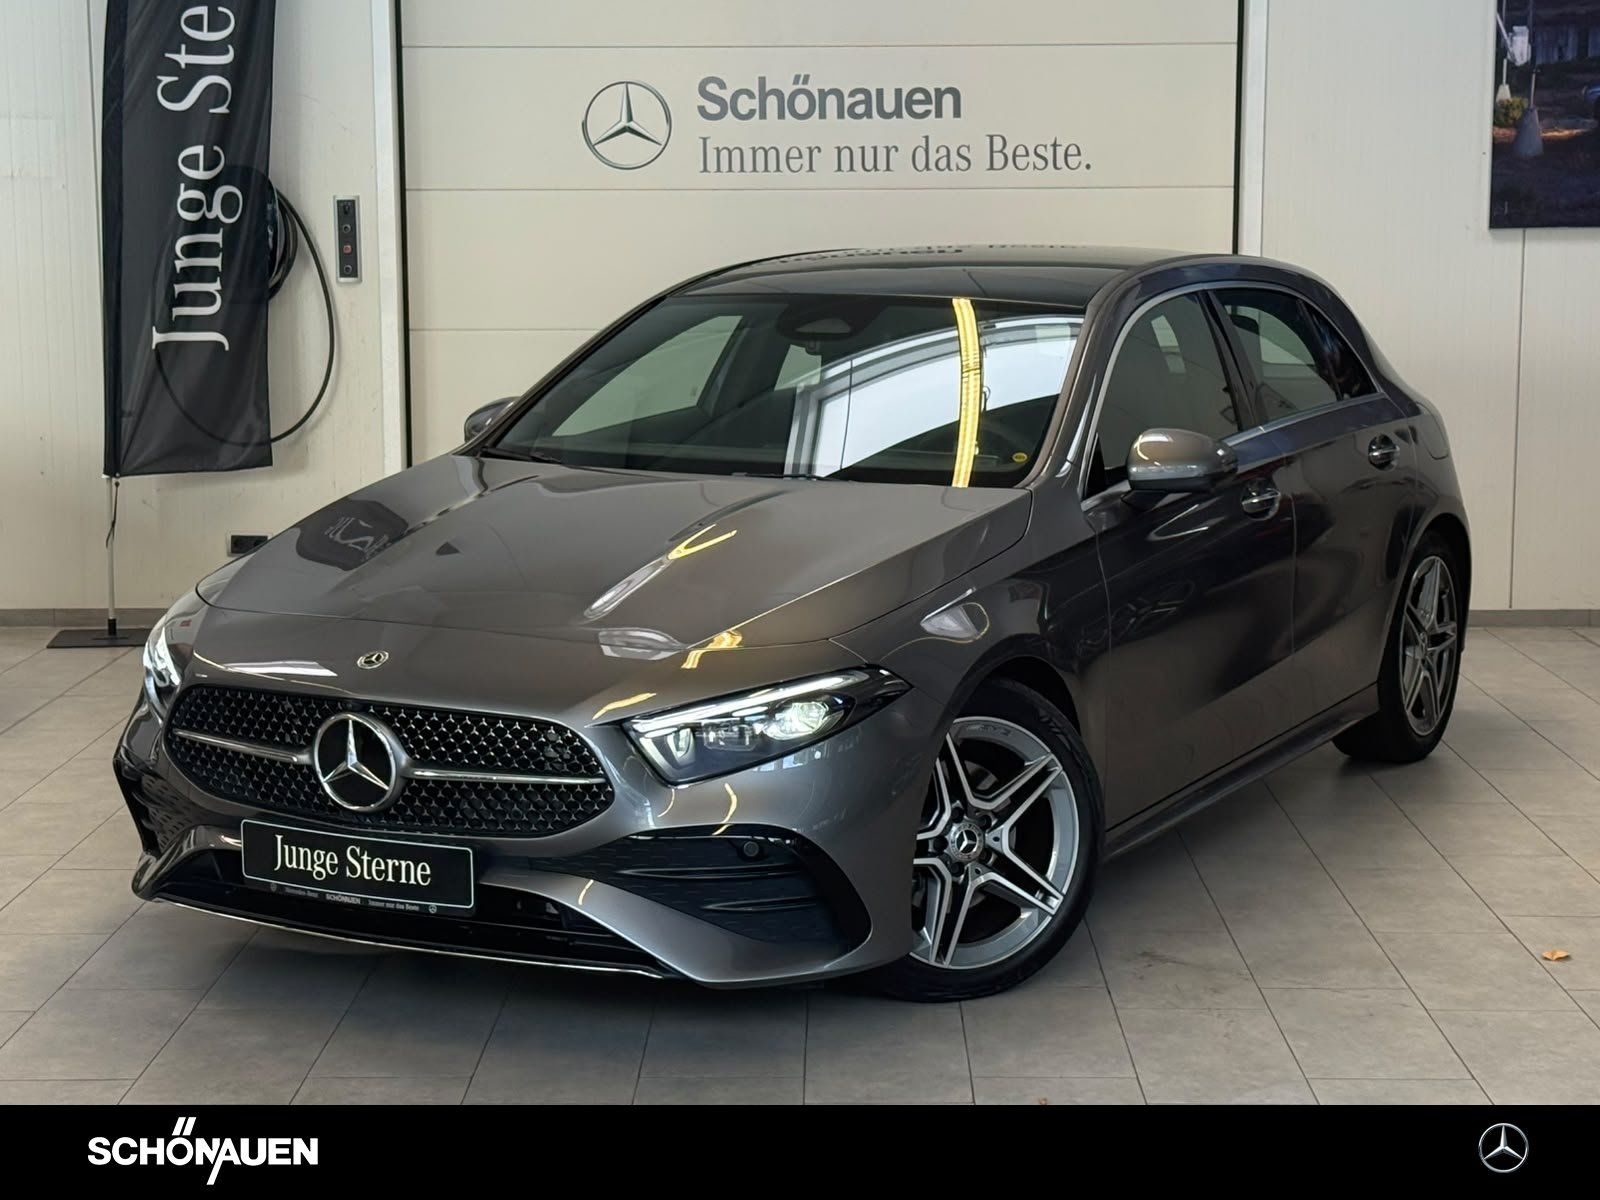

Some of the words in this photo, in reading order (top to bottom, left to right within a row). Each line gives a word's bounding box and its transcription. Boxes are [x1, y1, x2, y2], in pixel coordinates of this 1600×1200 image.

[697, 74, 962, 121] Schönauen
[699, 136, 822, 174] Immer
[834, 145, 899, 173] nur
[911, 135, 972, 173] das
[985, 134, 1092, 171] Beste.
[151, 145, 243, 351] Junge
[274, 834, 339, 881] Junge
[345, 845, 432, 886] Sterne
